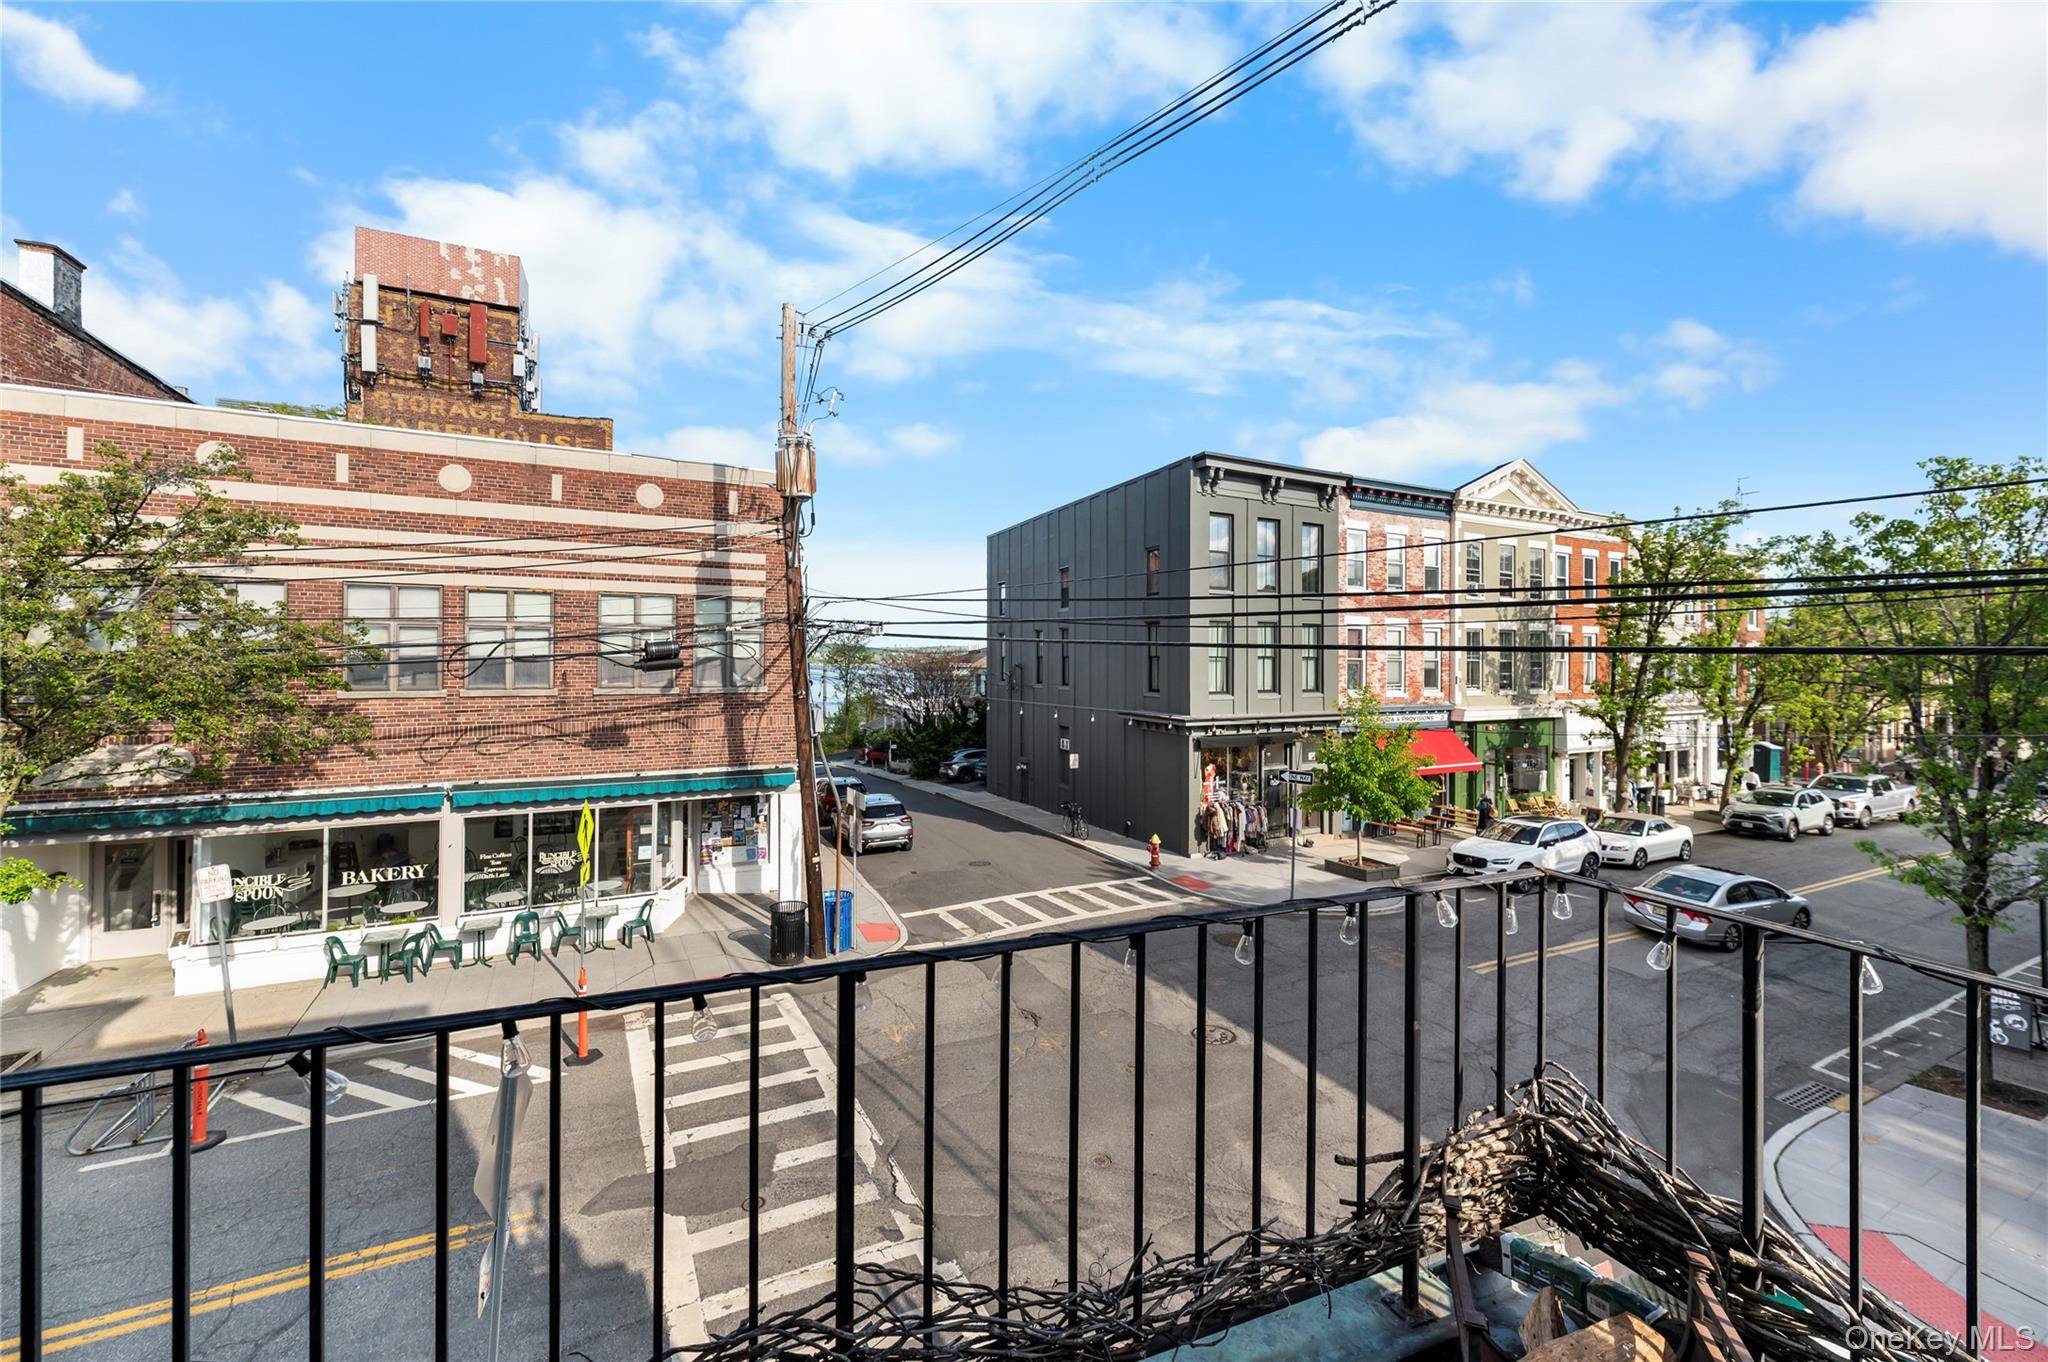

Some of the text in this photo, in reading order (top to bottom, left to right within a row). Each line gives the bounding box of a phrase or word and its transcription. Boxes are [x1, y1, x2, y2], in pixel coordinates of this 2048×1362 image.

[374, 391, 505, 422] STORAGE
[231, 873, 287, 887] NCIBLE
[341, 863, 429, 886] BAKERY
[235, 886, 284, 903] SPOON
